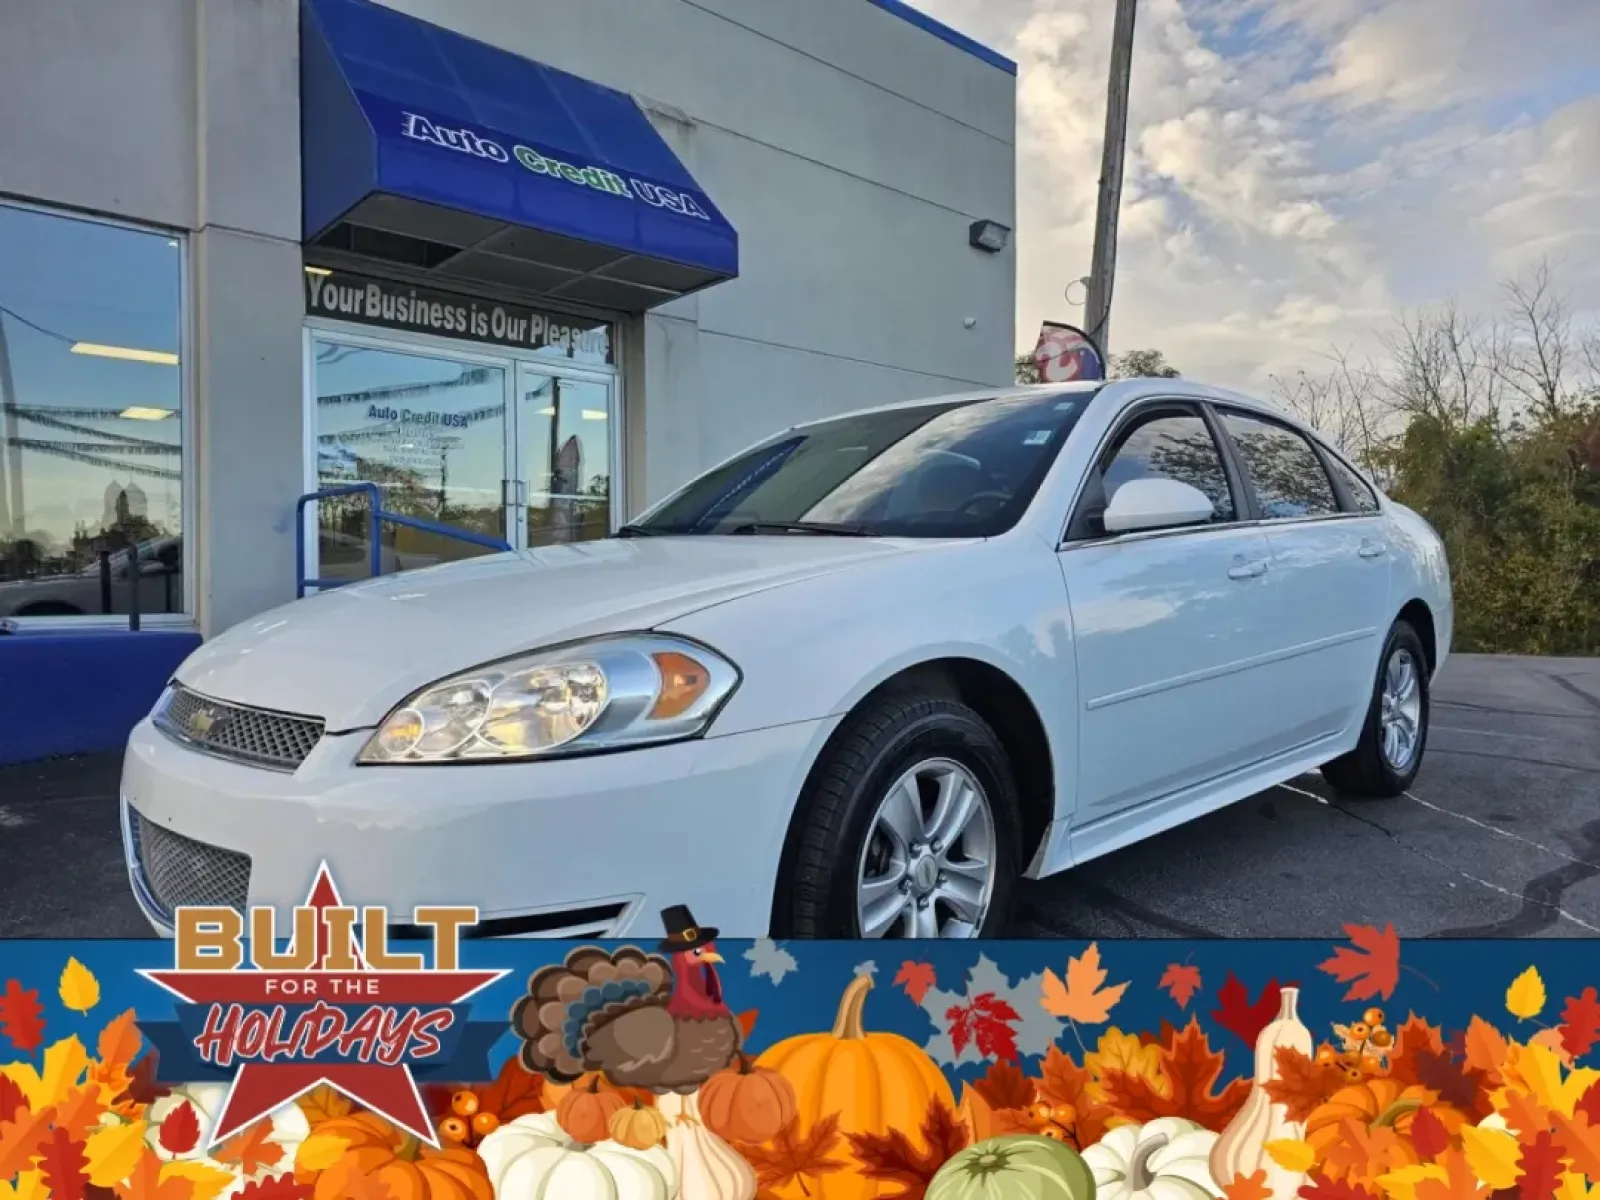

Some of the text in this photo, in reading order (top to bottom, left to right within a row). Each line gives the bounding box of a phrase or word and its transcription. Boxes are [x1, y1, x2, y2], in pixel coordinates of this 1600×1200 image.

[400, 110, 711, 221] Auto Credit USA
[307, 273, 364, 315] Your
[365, 283, 467, 332] Business
[470, 303, 488, 337] is
[491, 306, 527, 341] Our
[368, 404, 468, 429] Auto Credit USA
